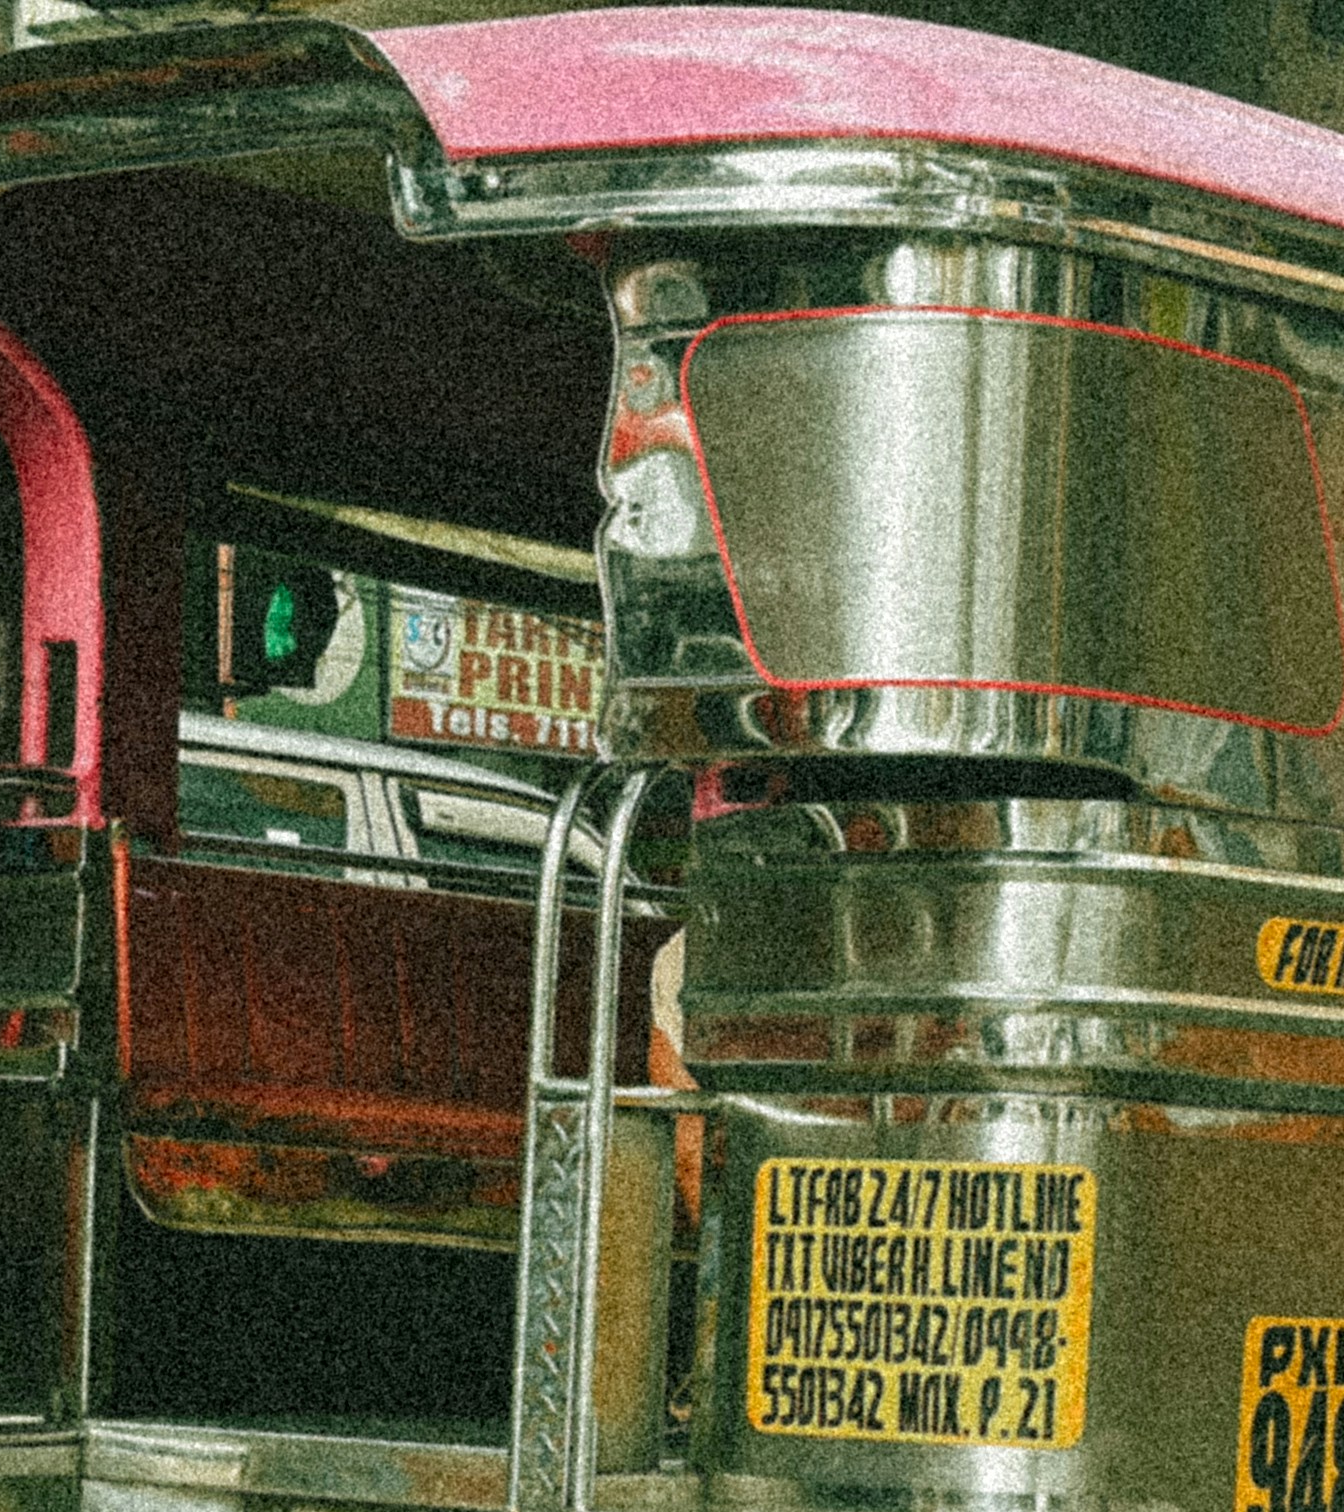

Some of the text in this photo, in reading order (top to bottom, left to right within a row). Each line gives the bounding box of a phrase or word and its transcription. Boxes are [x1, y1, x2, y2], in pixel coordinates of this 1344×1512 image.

[459, 650, 604, 712] PRIN
[427, 699, 521, 742] Tels.
[1274, 923, 1338, 987] FOR
[768, 1166, 1085, 1233] LTFRB 24/7 HOTLINE
[767, 1232, 817, 1293] TXT
[820, 1234, 905, 1296] VIBER
[1021, 1240, 1070, 1301] NO
[760, 1364, 885, 1431] 5501342
